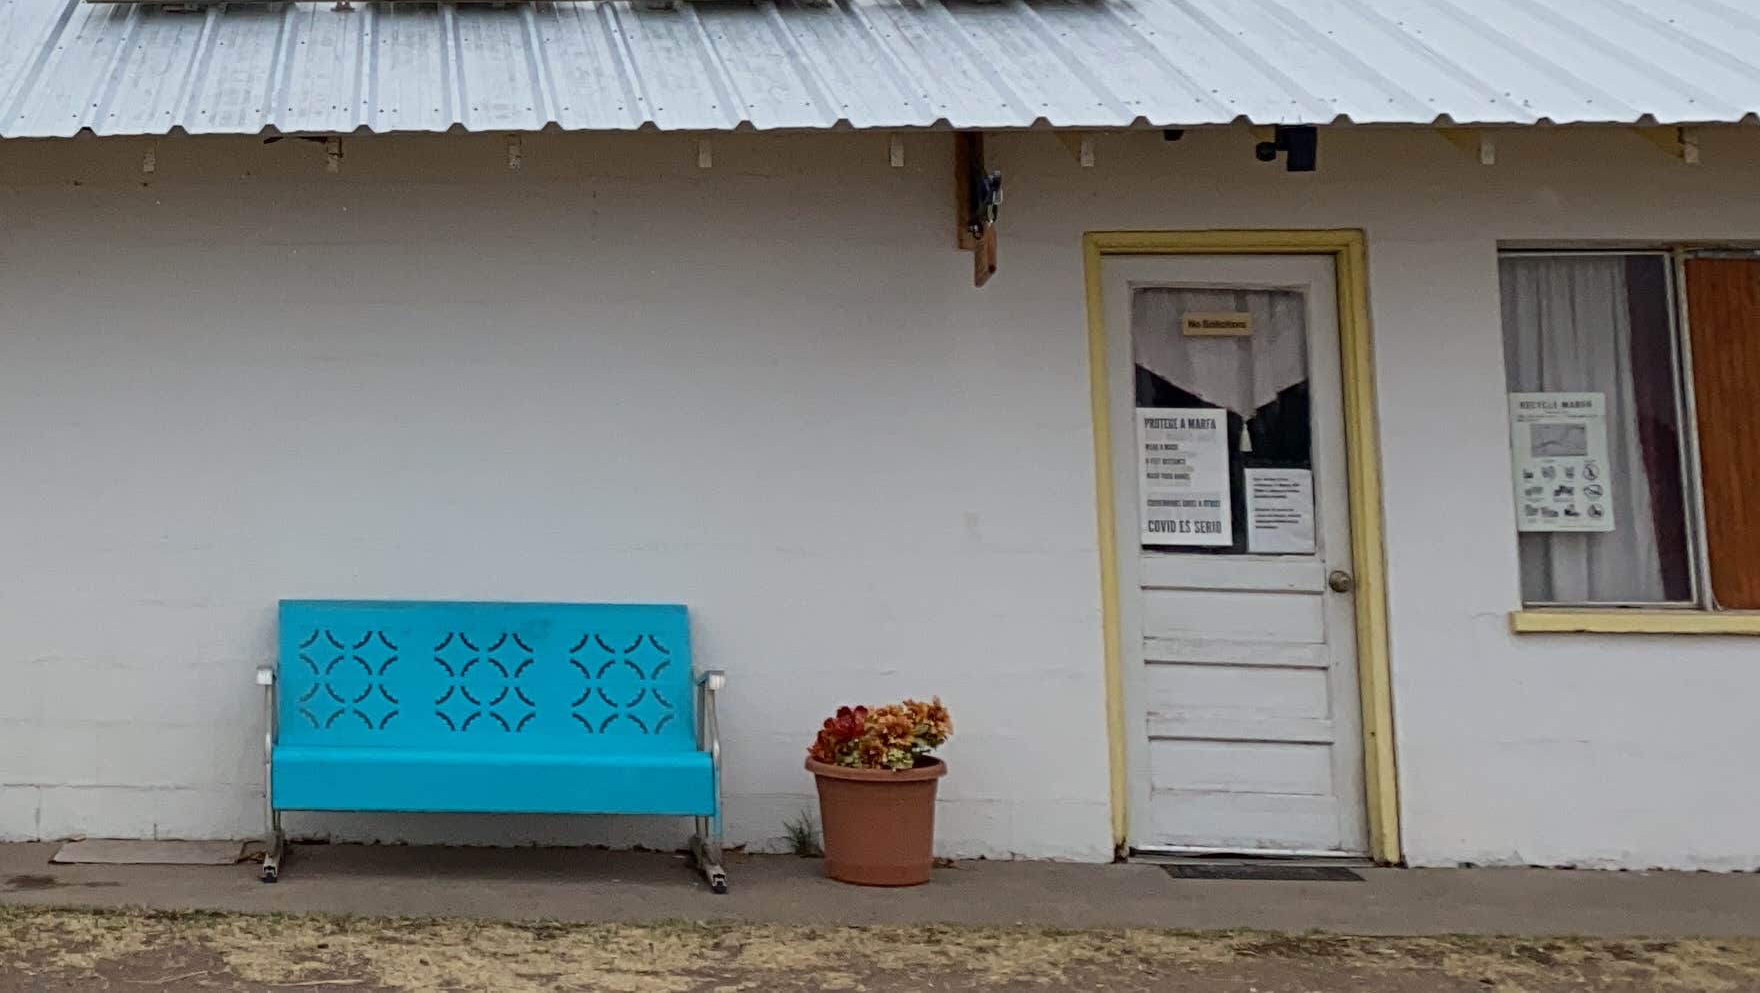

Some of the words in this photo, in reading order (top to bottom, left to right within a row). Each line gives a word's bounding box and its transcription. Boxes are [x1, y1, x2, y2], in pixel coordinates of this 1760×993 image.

[1180, 417, 1186, 429] A
[1148, 519, 1177, 533] COVID
[1179, 519, 1192, 534] ES
[1194, 520, 1222, 534] SERIO
